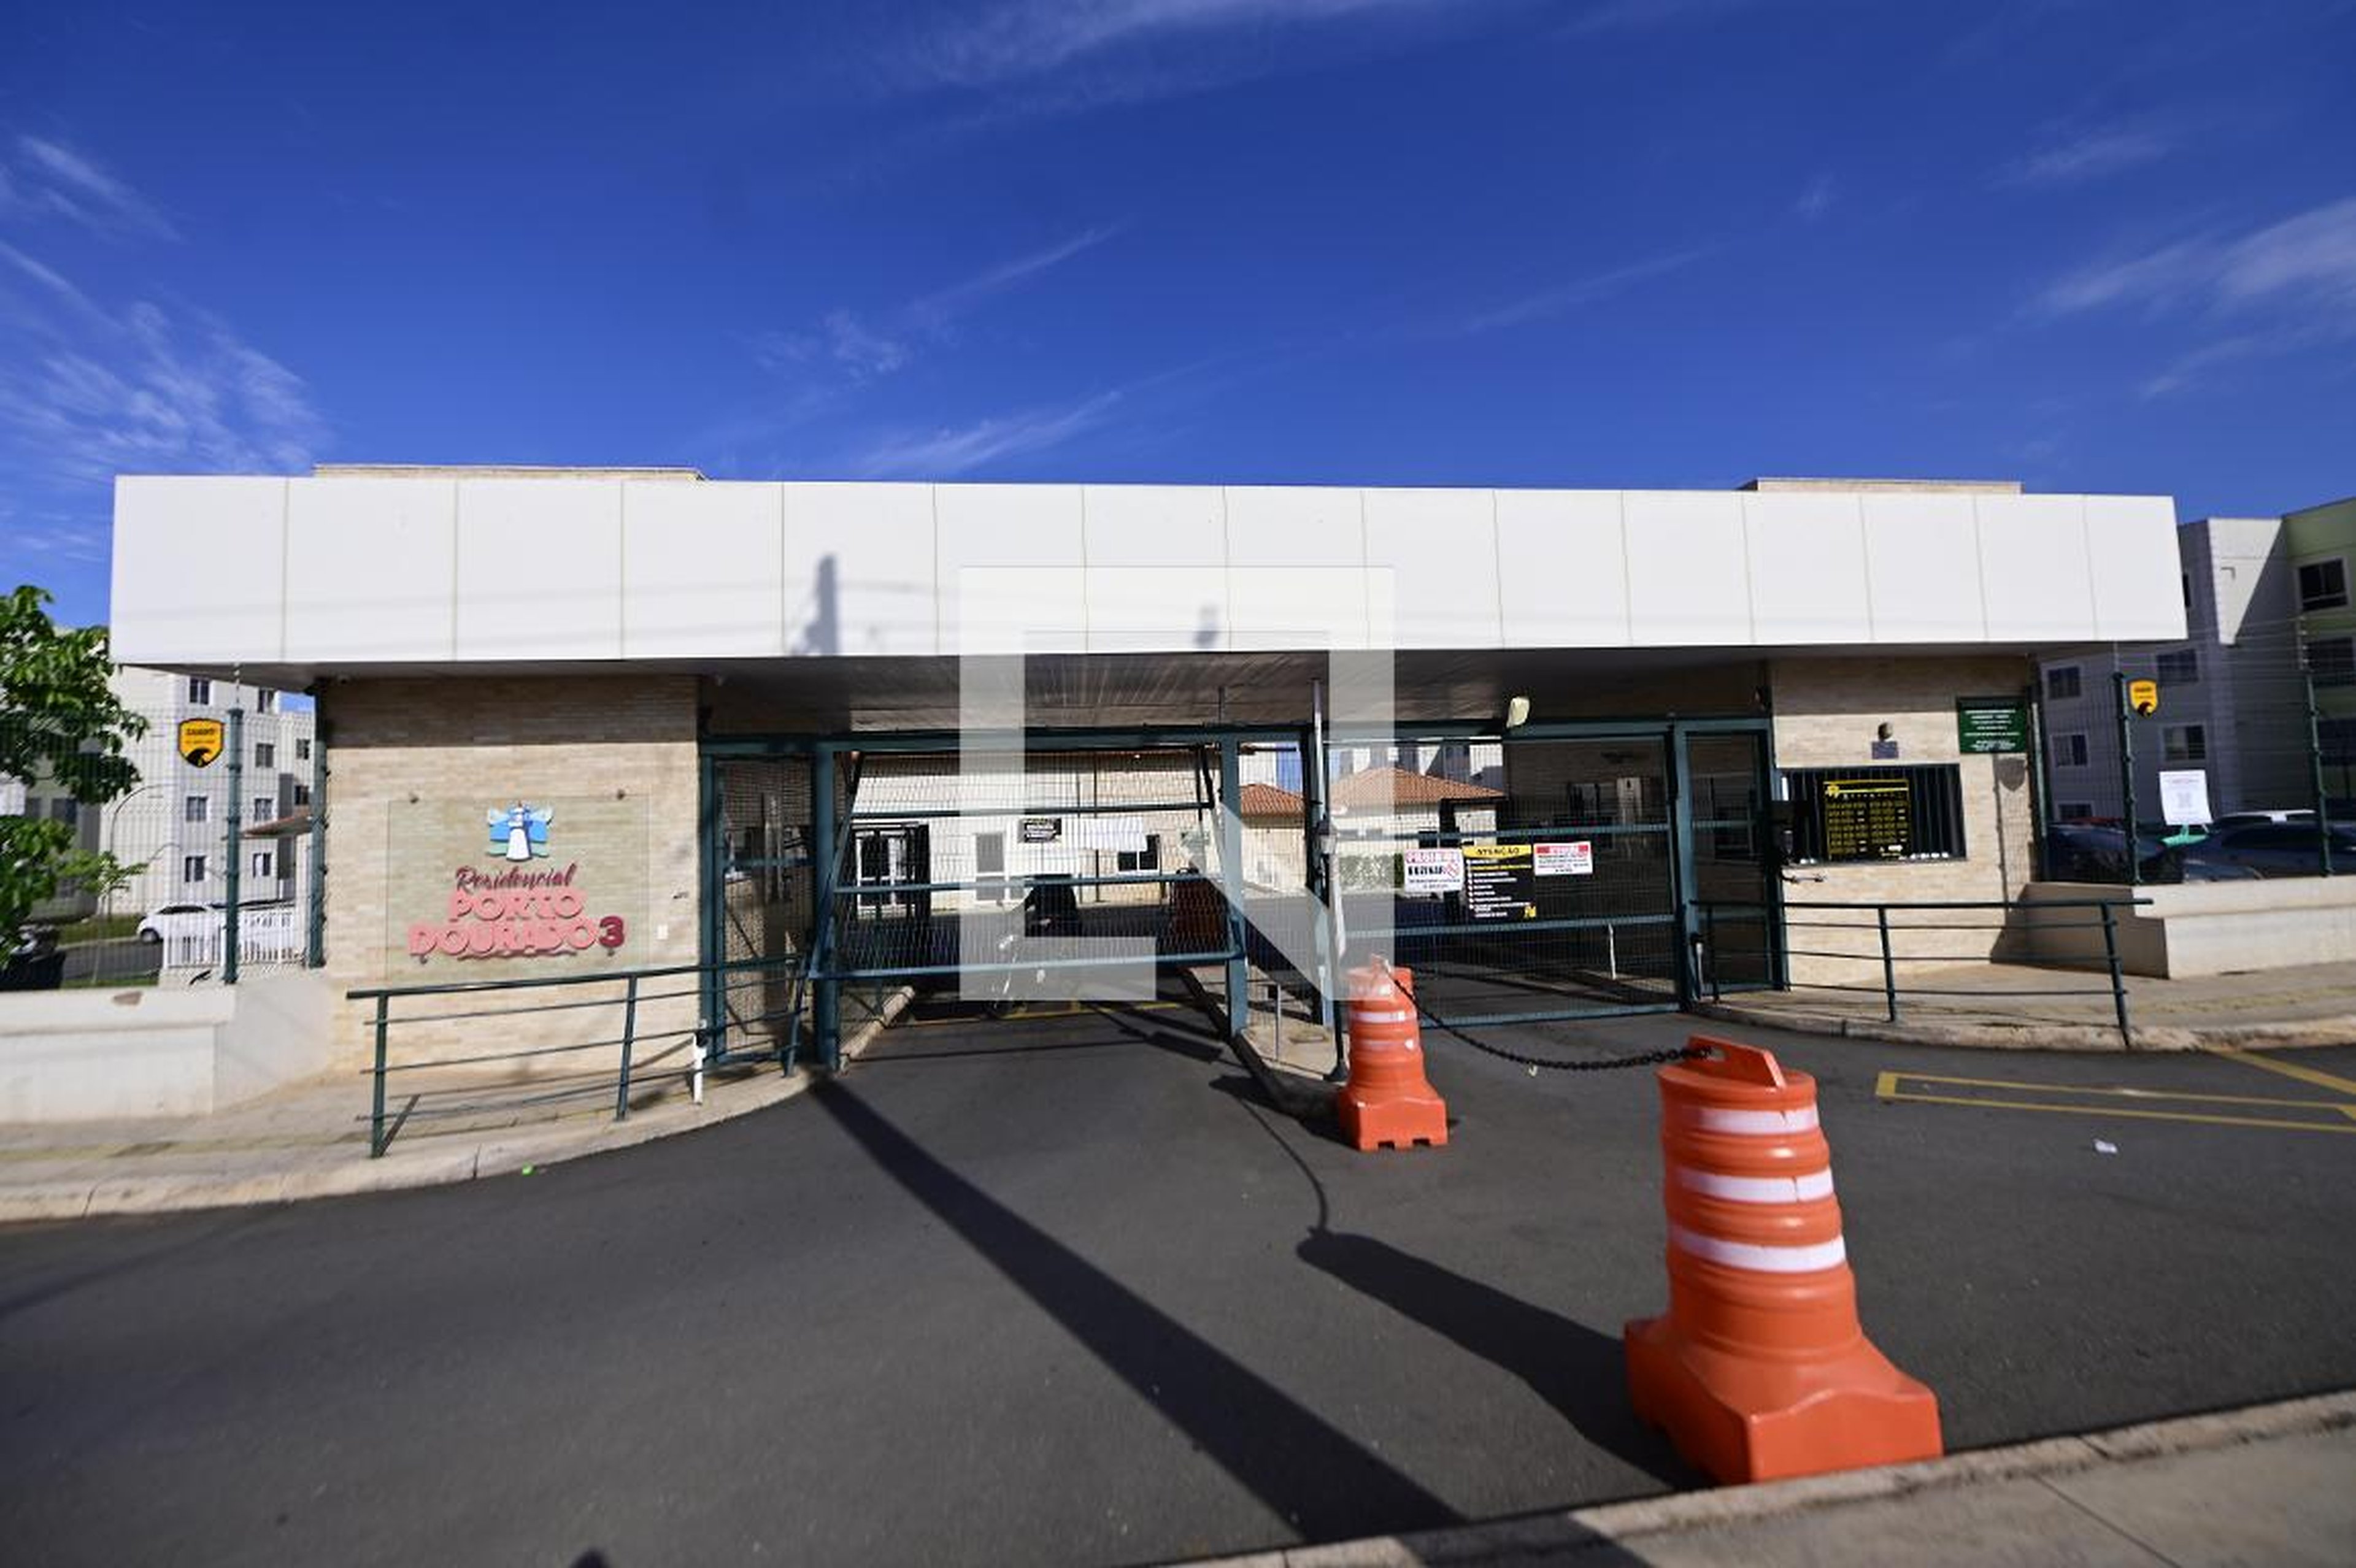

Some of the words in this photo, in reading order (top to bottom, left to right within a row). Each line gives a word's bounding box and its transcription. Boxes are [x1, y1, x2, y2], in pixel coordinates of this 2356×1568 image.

[455, 863, 577, 891] Residencial
[449, 890, 586, 921] PORTO
[409, 918, 596, 955] DOURADO
[599, 916, 625, 947] 3
